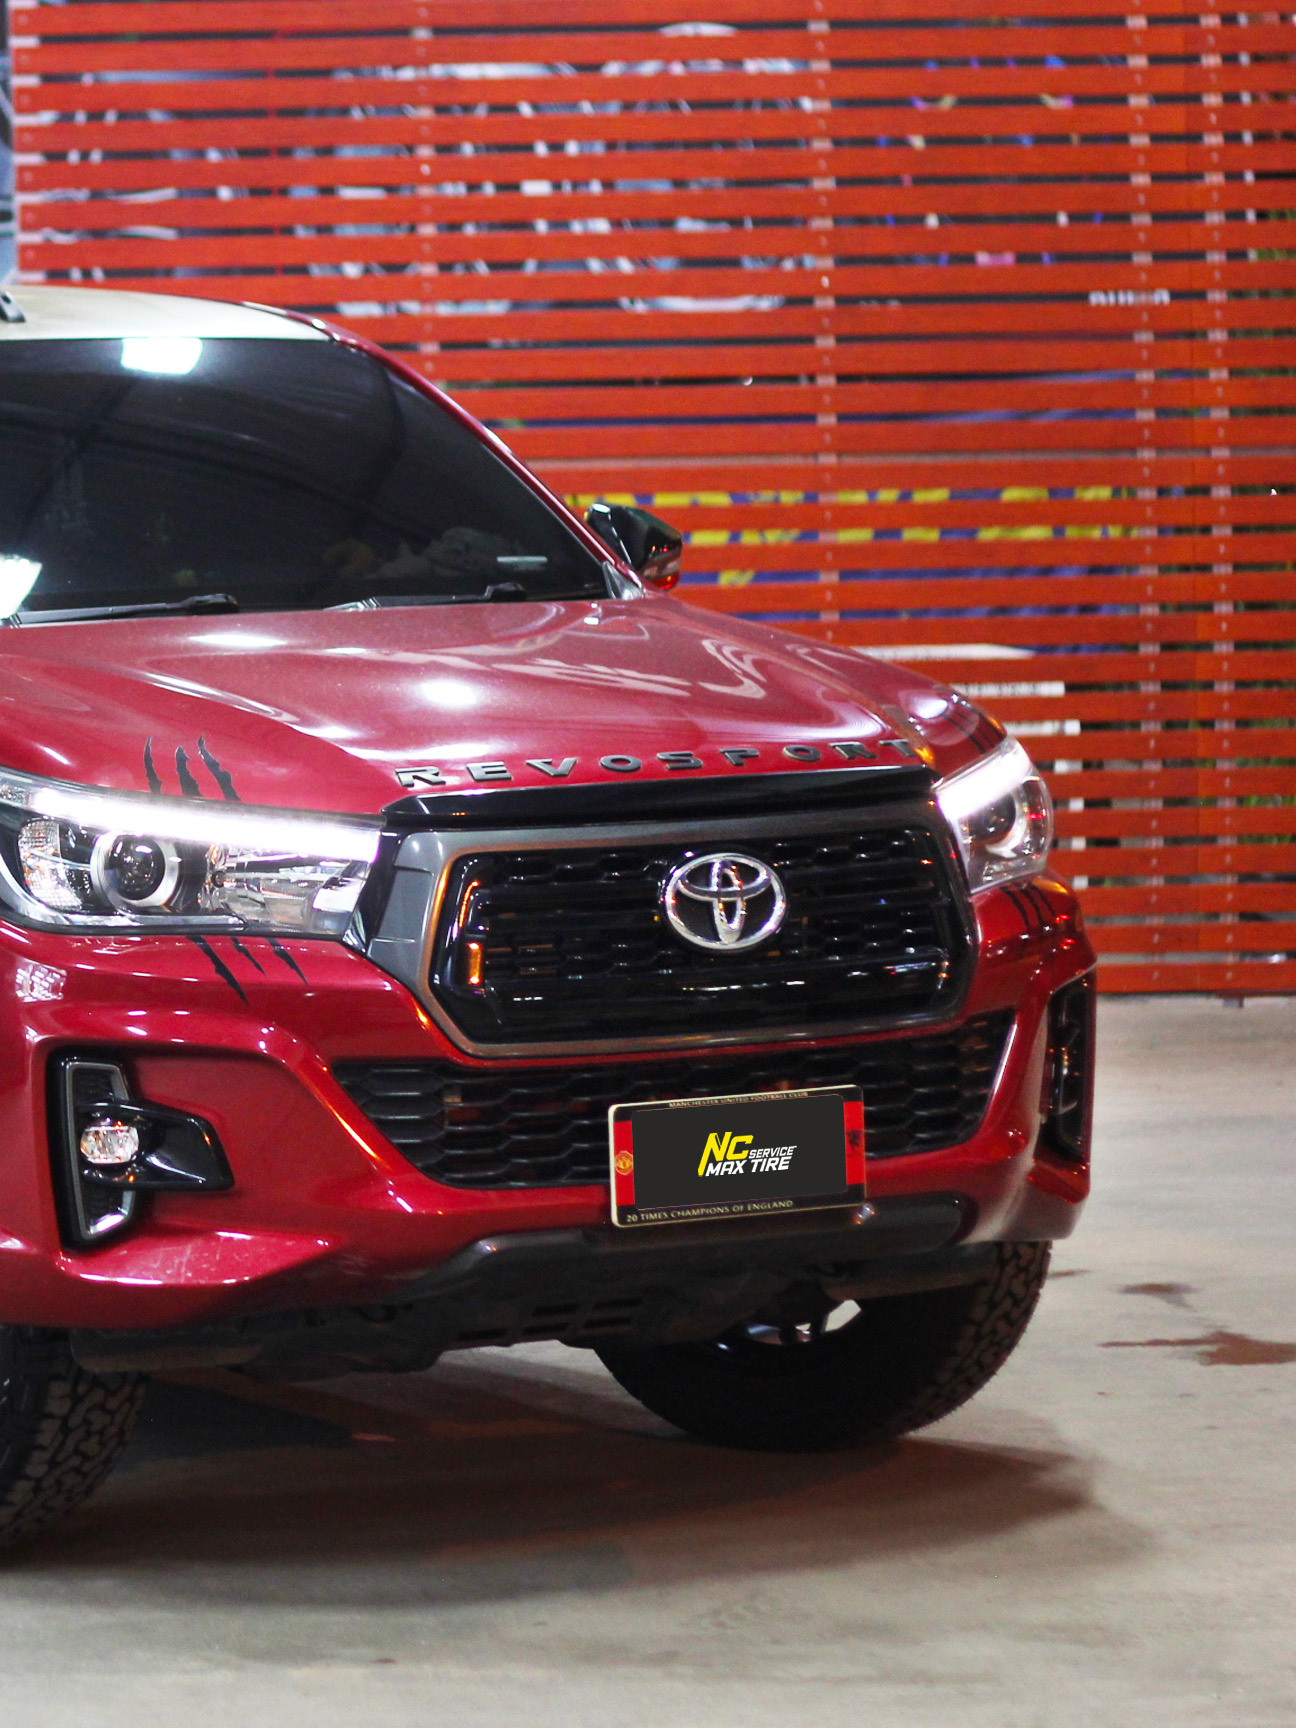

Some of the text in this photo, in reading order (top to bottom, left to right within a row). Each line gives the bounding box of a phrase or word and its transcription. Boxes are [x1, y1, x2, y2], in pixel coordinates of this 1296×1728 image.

[395, 739, 915, 788] REVOSPORT
[668, 1091, 809, 1108] MANCHESTER UNITED FOOTBALL CLUB
[626, 1200, 794, 1222] 20 TIMES CHAMPIONS OF ENGLAND
